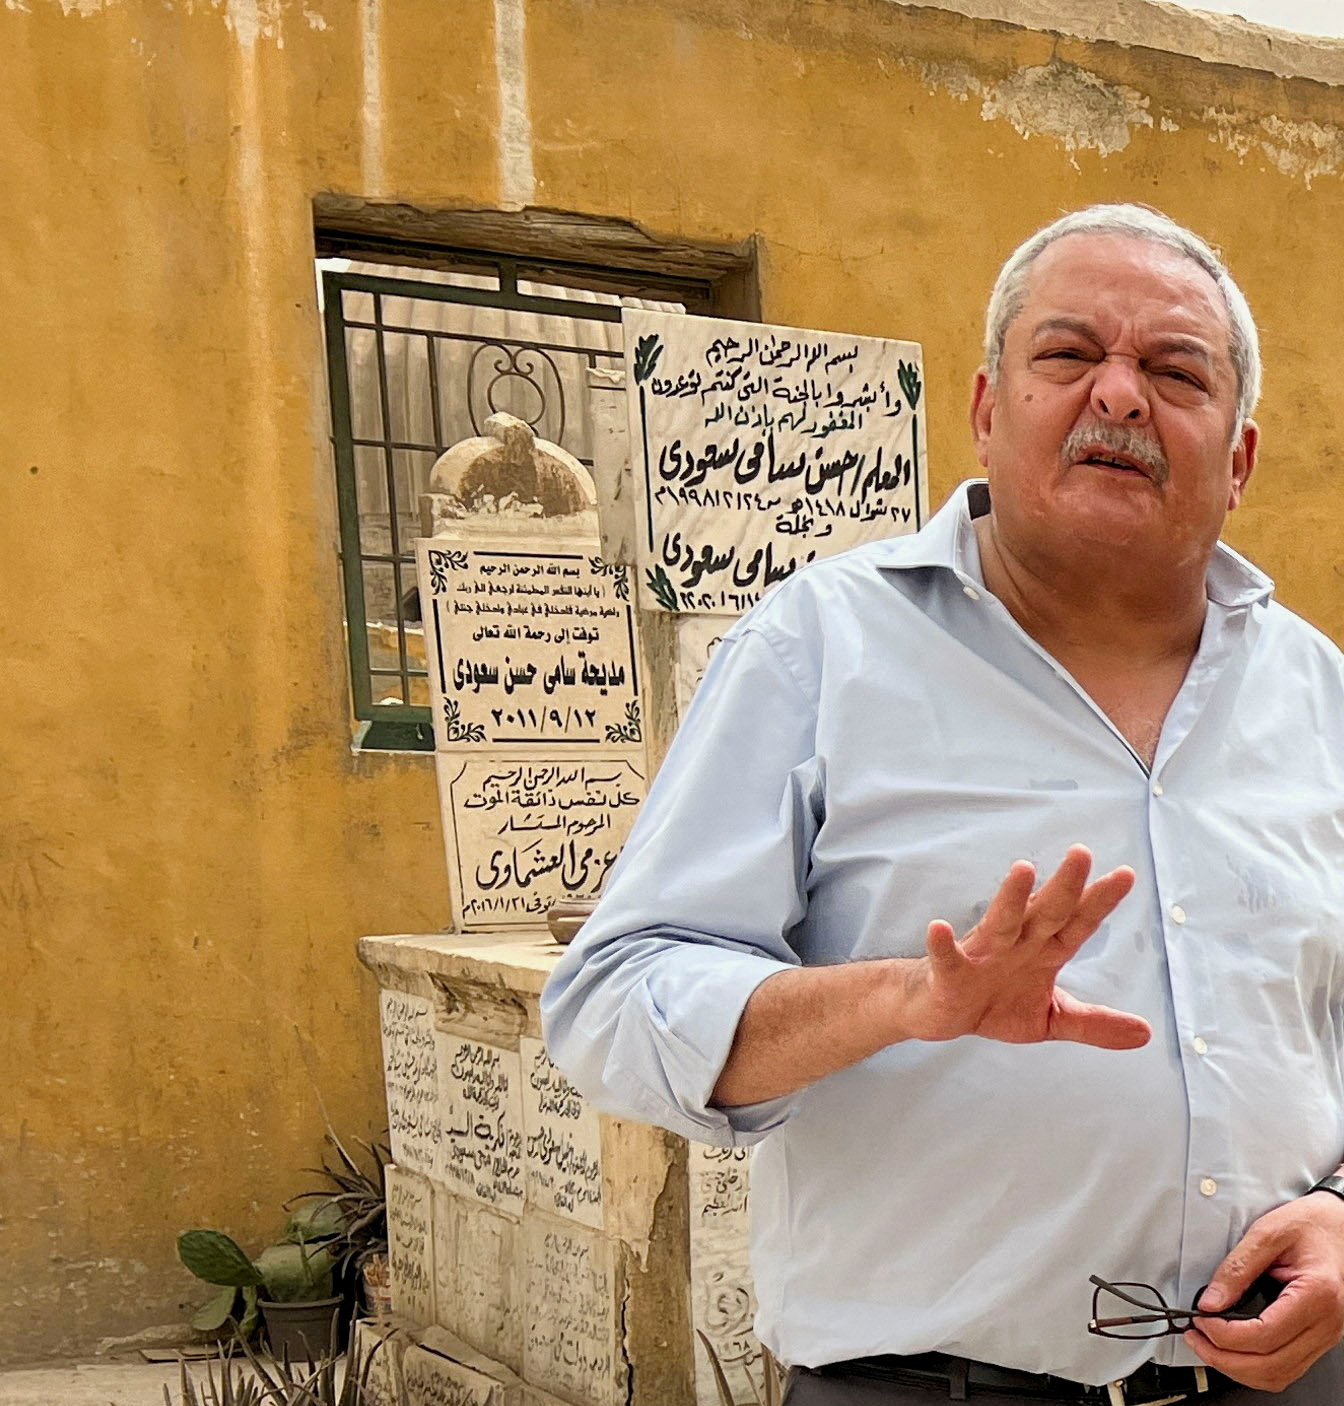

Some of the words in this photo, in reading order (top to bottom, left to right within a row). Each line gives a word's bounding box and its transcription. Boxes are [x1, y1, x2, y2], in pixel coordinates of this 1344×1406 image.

[705, 337, 759, 368] الرحيم
[825, 345, 858, 374] بسم
[701, 366, 742, 405] كنتم
[705, 402, 732, 428] الله
[778, 401, 807, 432] لهم
[800, 409, 863, 438] المغفور
[805, 446, 860, 495] حسن
[850, 497, 888, 522] شوال
[480, 563, 511, 576] الرحيم
[513, 563, 544, 576] الرحمن
[547, 563, 561, 575] الله
[563, 567, 580, 579] بسم
[472, 625, 500, 641] تعالى
[503, 624, 521, 638] الله
[525, 625, 551, 642] رحمة
[504, 656, 537, 695] حسن
[578, 651, 626, 696] مديحة
[555, 768, 585, 787] الله
[464, 789, 510, 811] الموت
[558, 790, 606, 810] نفس
[608, 792, 641, 809] كل
[497, 812, 567, 835] المستشار
[566, 813, 611, 836] المرحوم
